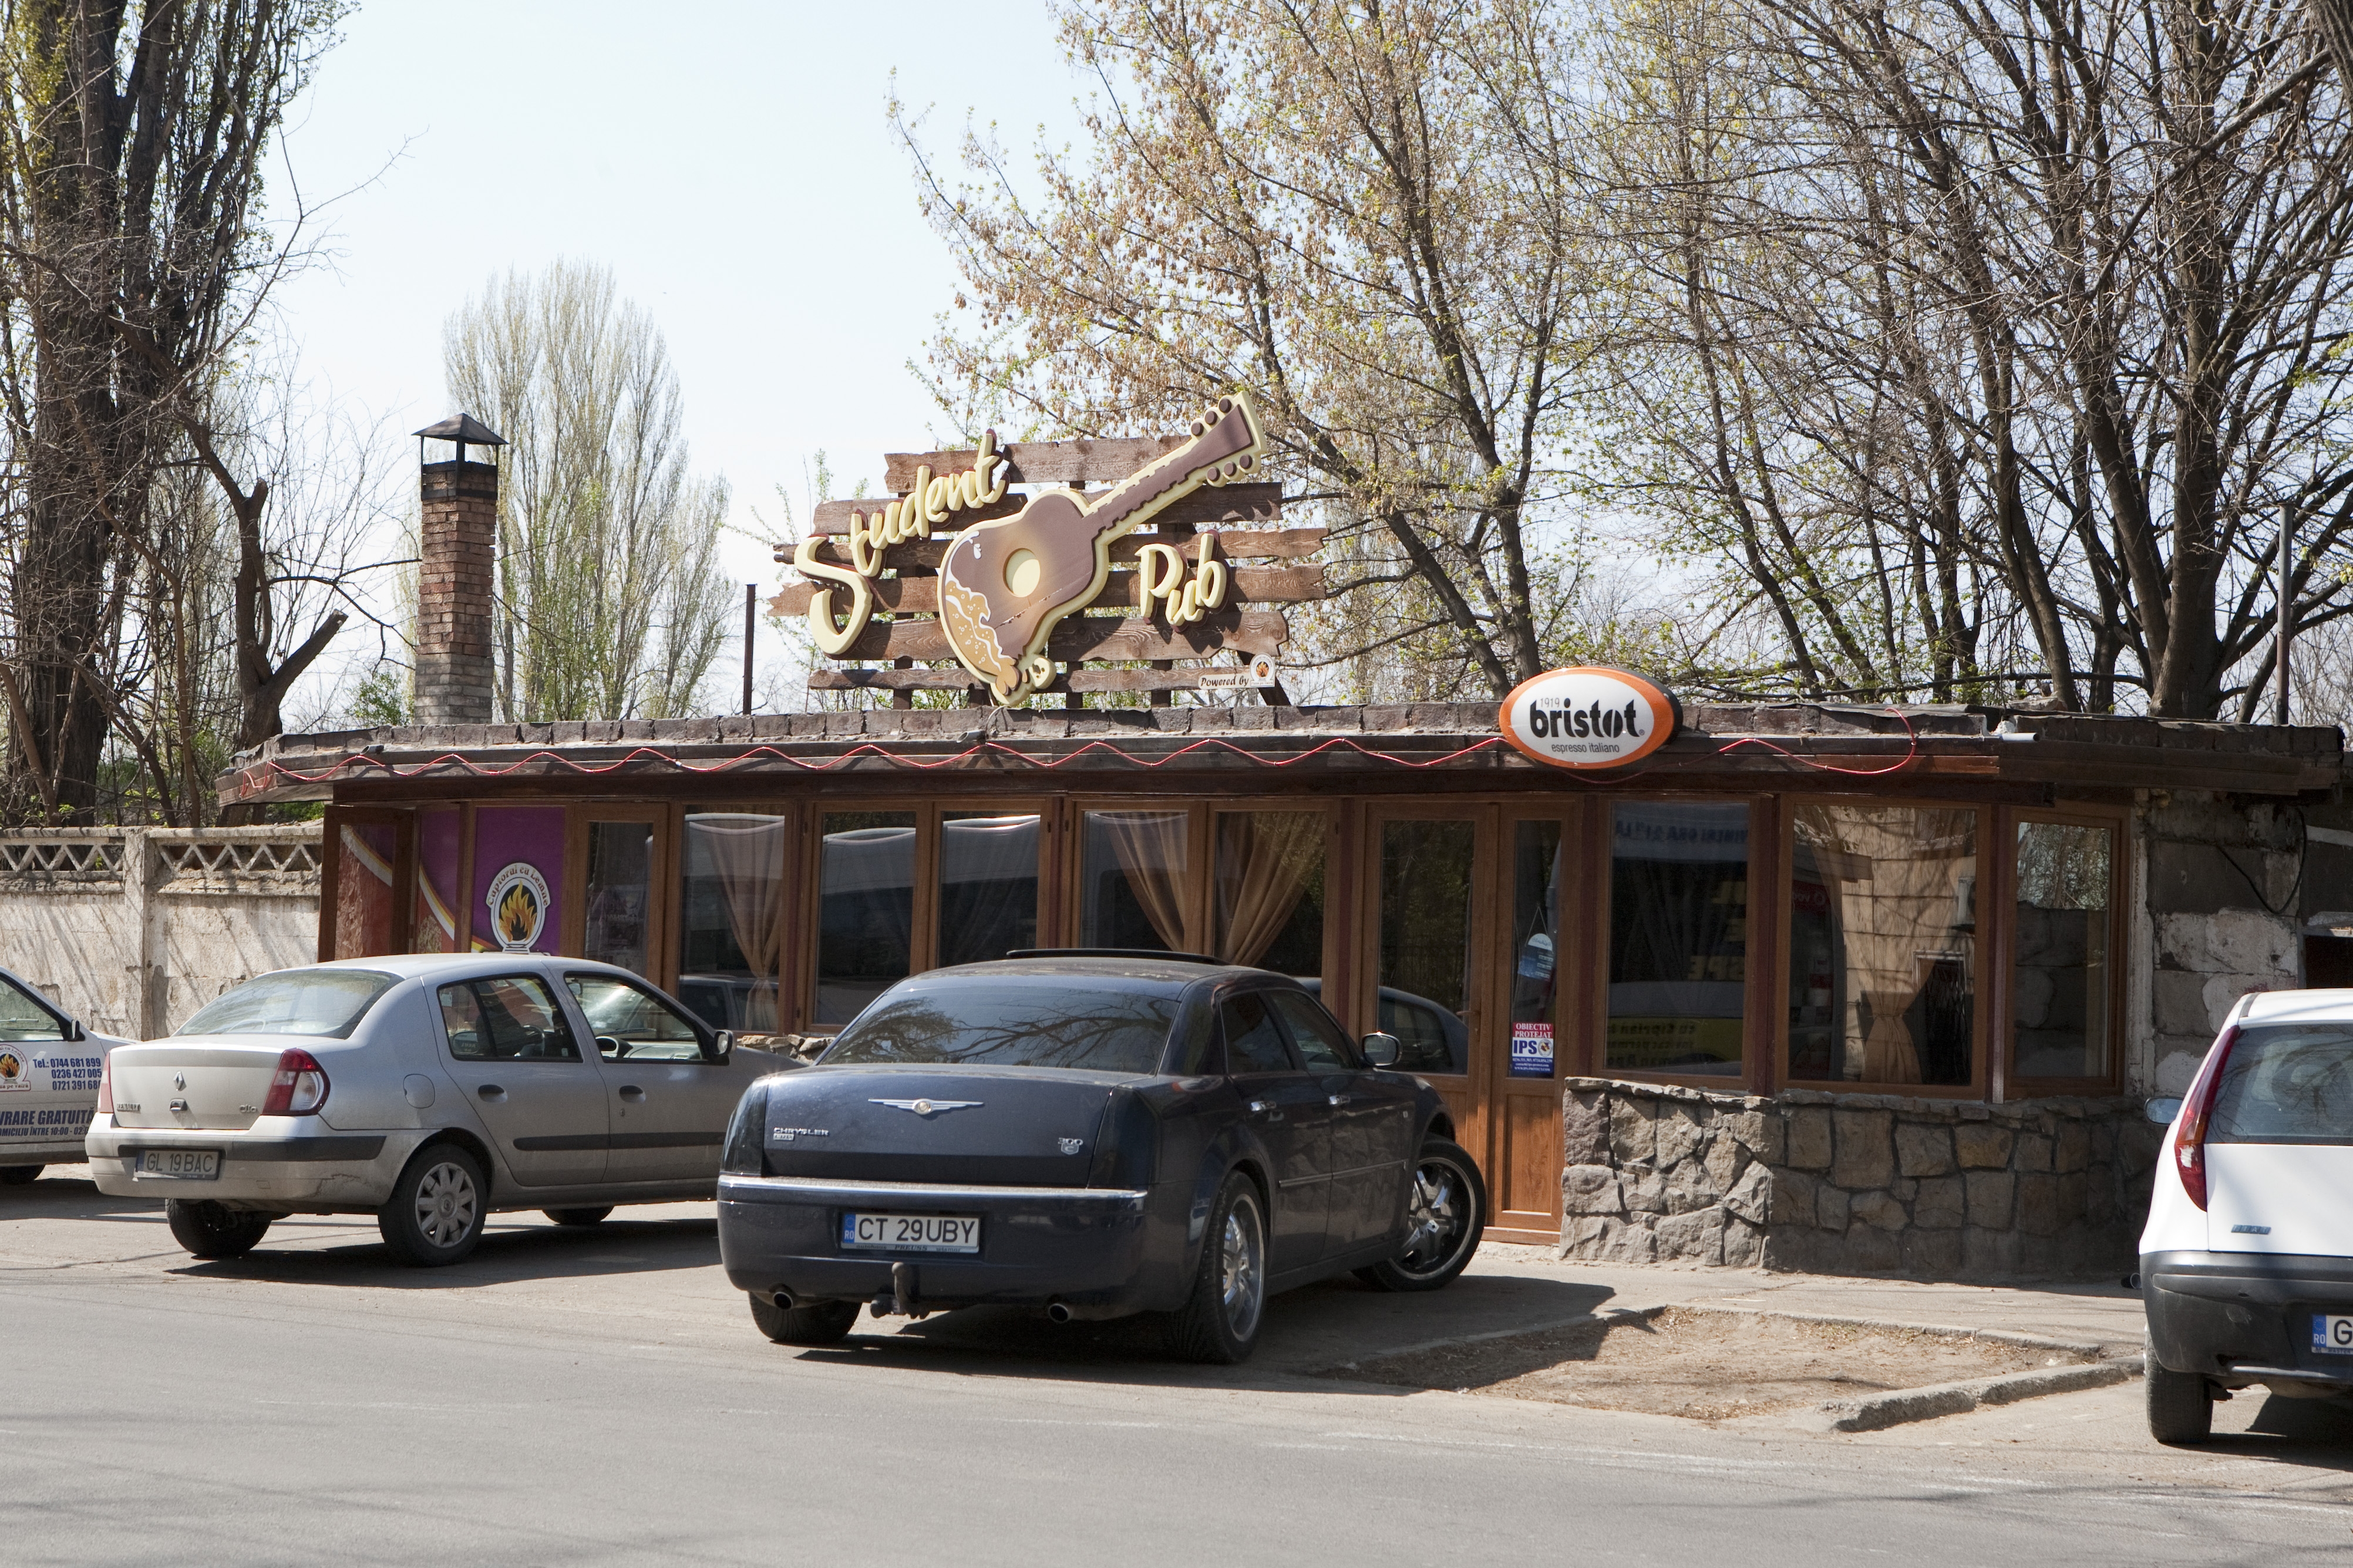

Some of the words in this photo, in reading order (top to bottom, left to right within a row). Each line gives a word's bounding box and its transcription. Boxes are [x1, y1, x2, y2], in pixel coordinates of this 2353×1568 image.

[793, 429, 1011, 657] Student
[1134, 529, 1232, 633] Pub
[1201, 676, 1236, 687] Powered
[1239, 675, 1249, 687] by
[1540, 697, 1560, 708] 1919
[1529, 697, 1640, 739] bristot
[1551, 743, 1587, 754] espresso
[1588, 742, 1620, 753] italiano
[520, 866, 530, 876] cu
[1513, 1040, 1537, 1055] IPS
[33, 1058, 50, 1068] Tel.:
[50, 1058, 69, 1068] 0744
[70, 1058, 85, 1068] 681
[85, 1057, 101, 1067] 899
[51, 1069, 71, 1079] 0236
[73, 1069, 86, 1078] 427
[87, 1068, 102, 1078] 005
[52, 1081, 70, 1091] 0721
[72, 1081, 86, 1090] 391
[38, 1107, 95, 1125] GRATUITĂ
[29, 1127, 49, 1136] ÎNTRE
[51, 1127, 69, 1135] 10:00
[774, 1127, 829, 1136] CHRYSLER
[1058, 1137, 1083, 1145] 300
[147, 1153, 163, 1171] GL
[844, 1230, 854, 1239] RO
[859, 1218, 888, 1240] CT
[2231, 1225, 2270, 1234] FIAT
[2313, 1333, 2325, 1344] RO
[2334, 1319, 2353, 1346] G
